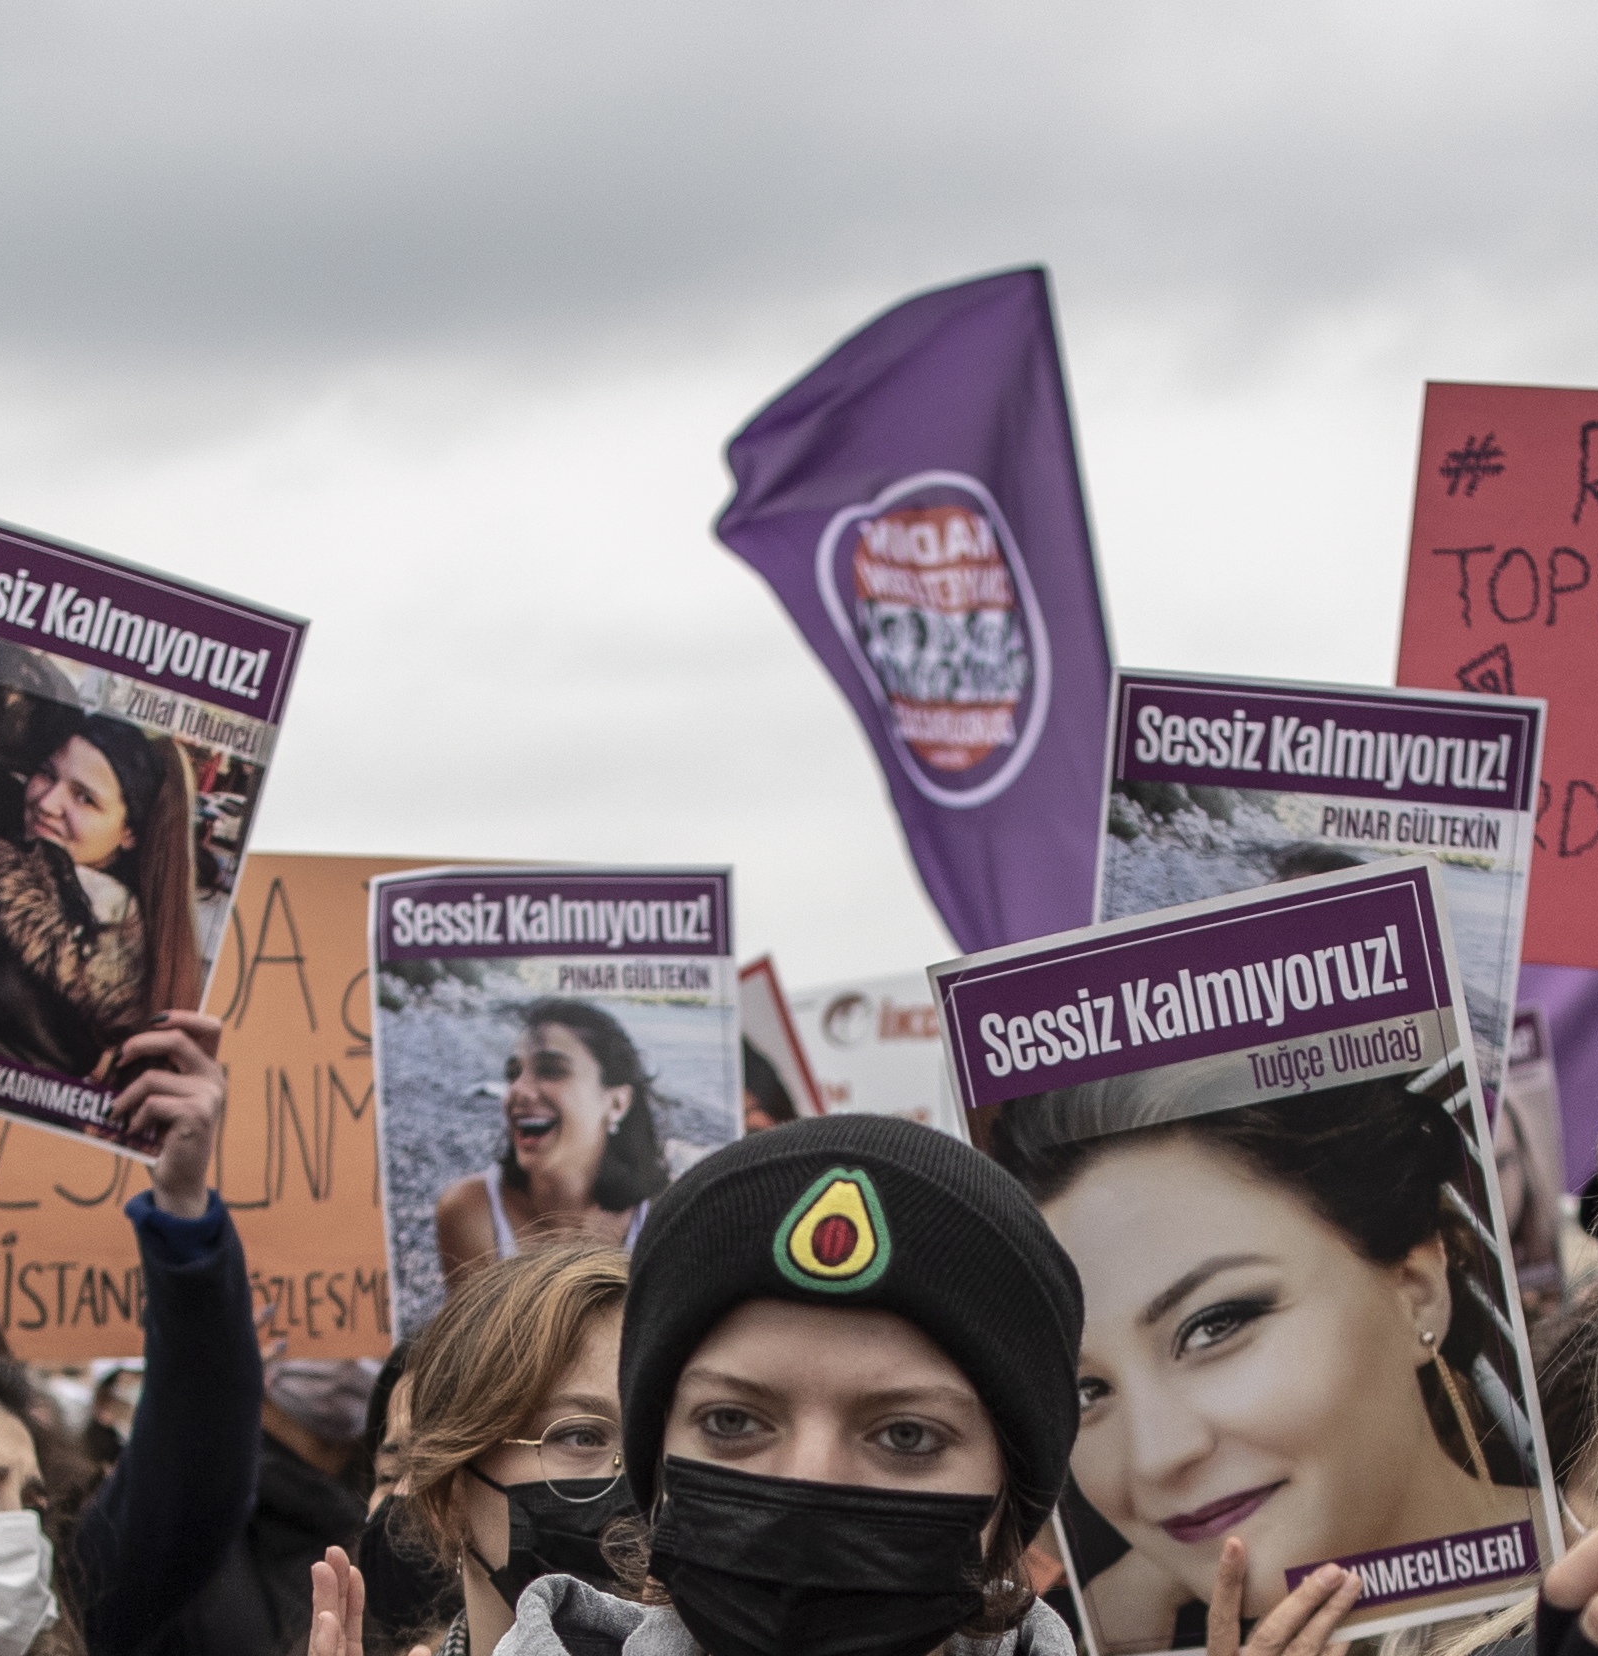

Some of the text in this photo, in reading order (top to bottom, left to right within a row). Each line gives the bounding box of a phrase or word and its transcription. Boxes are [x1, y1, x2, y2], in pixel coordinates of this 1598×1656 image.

[41, 581, 271, 701] Kalmıyoruz!
[1134, 704, 1511, 792] Sessiz Kalmıyoruz!
[1320, 805, 1502, 852] PINAR GÜLTEKİN
[391, 893, 712, 950] Sessiz Kalmıyoruz!
[559, 961, 712, 992] PINAR GÜLTEKİN
[978, 989, 1123, 1078] Sessiz
[1119, 924, 1409, 1046] Kalmıyoruz!
[1247, 1016, 1423, 1092] Tuğçe Uludağ
